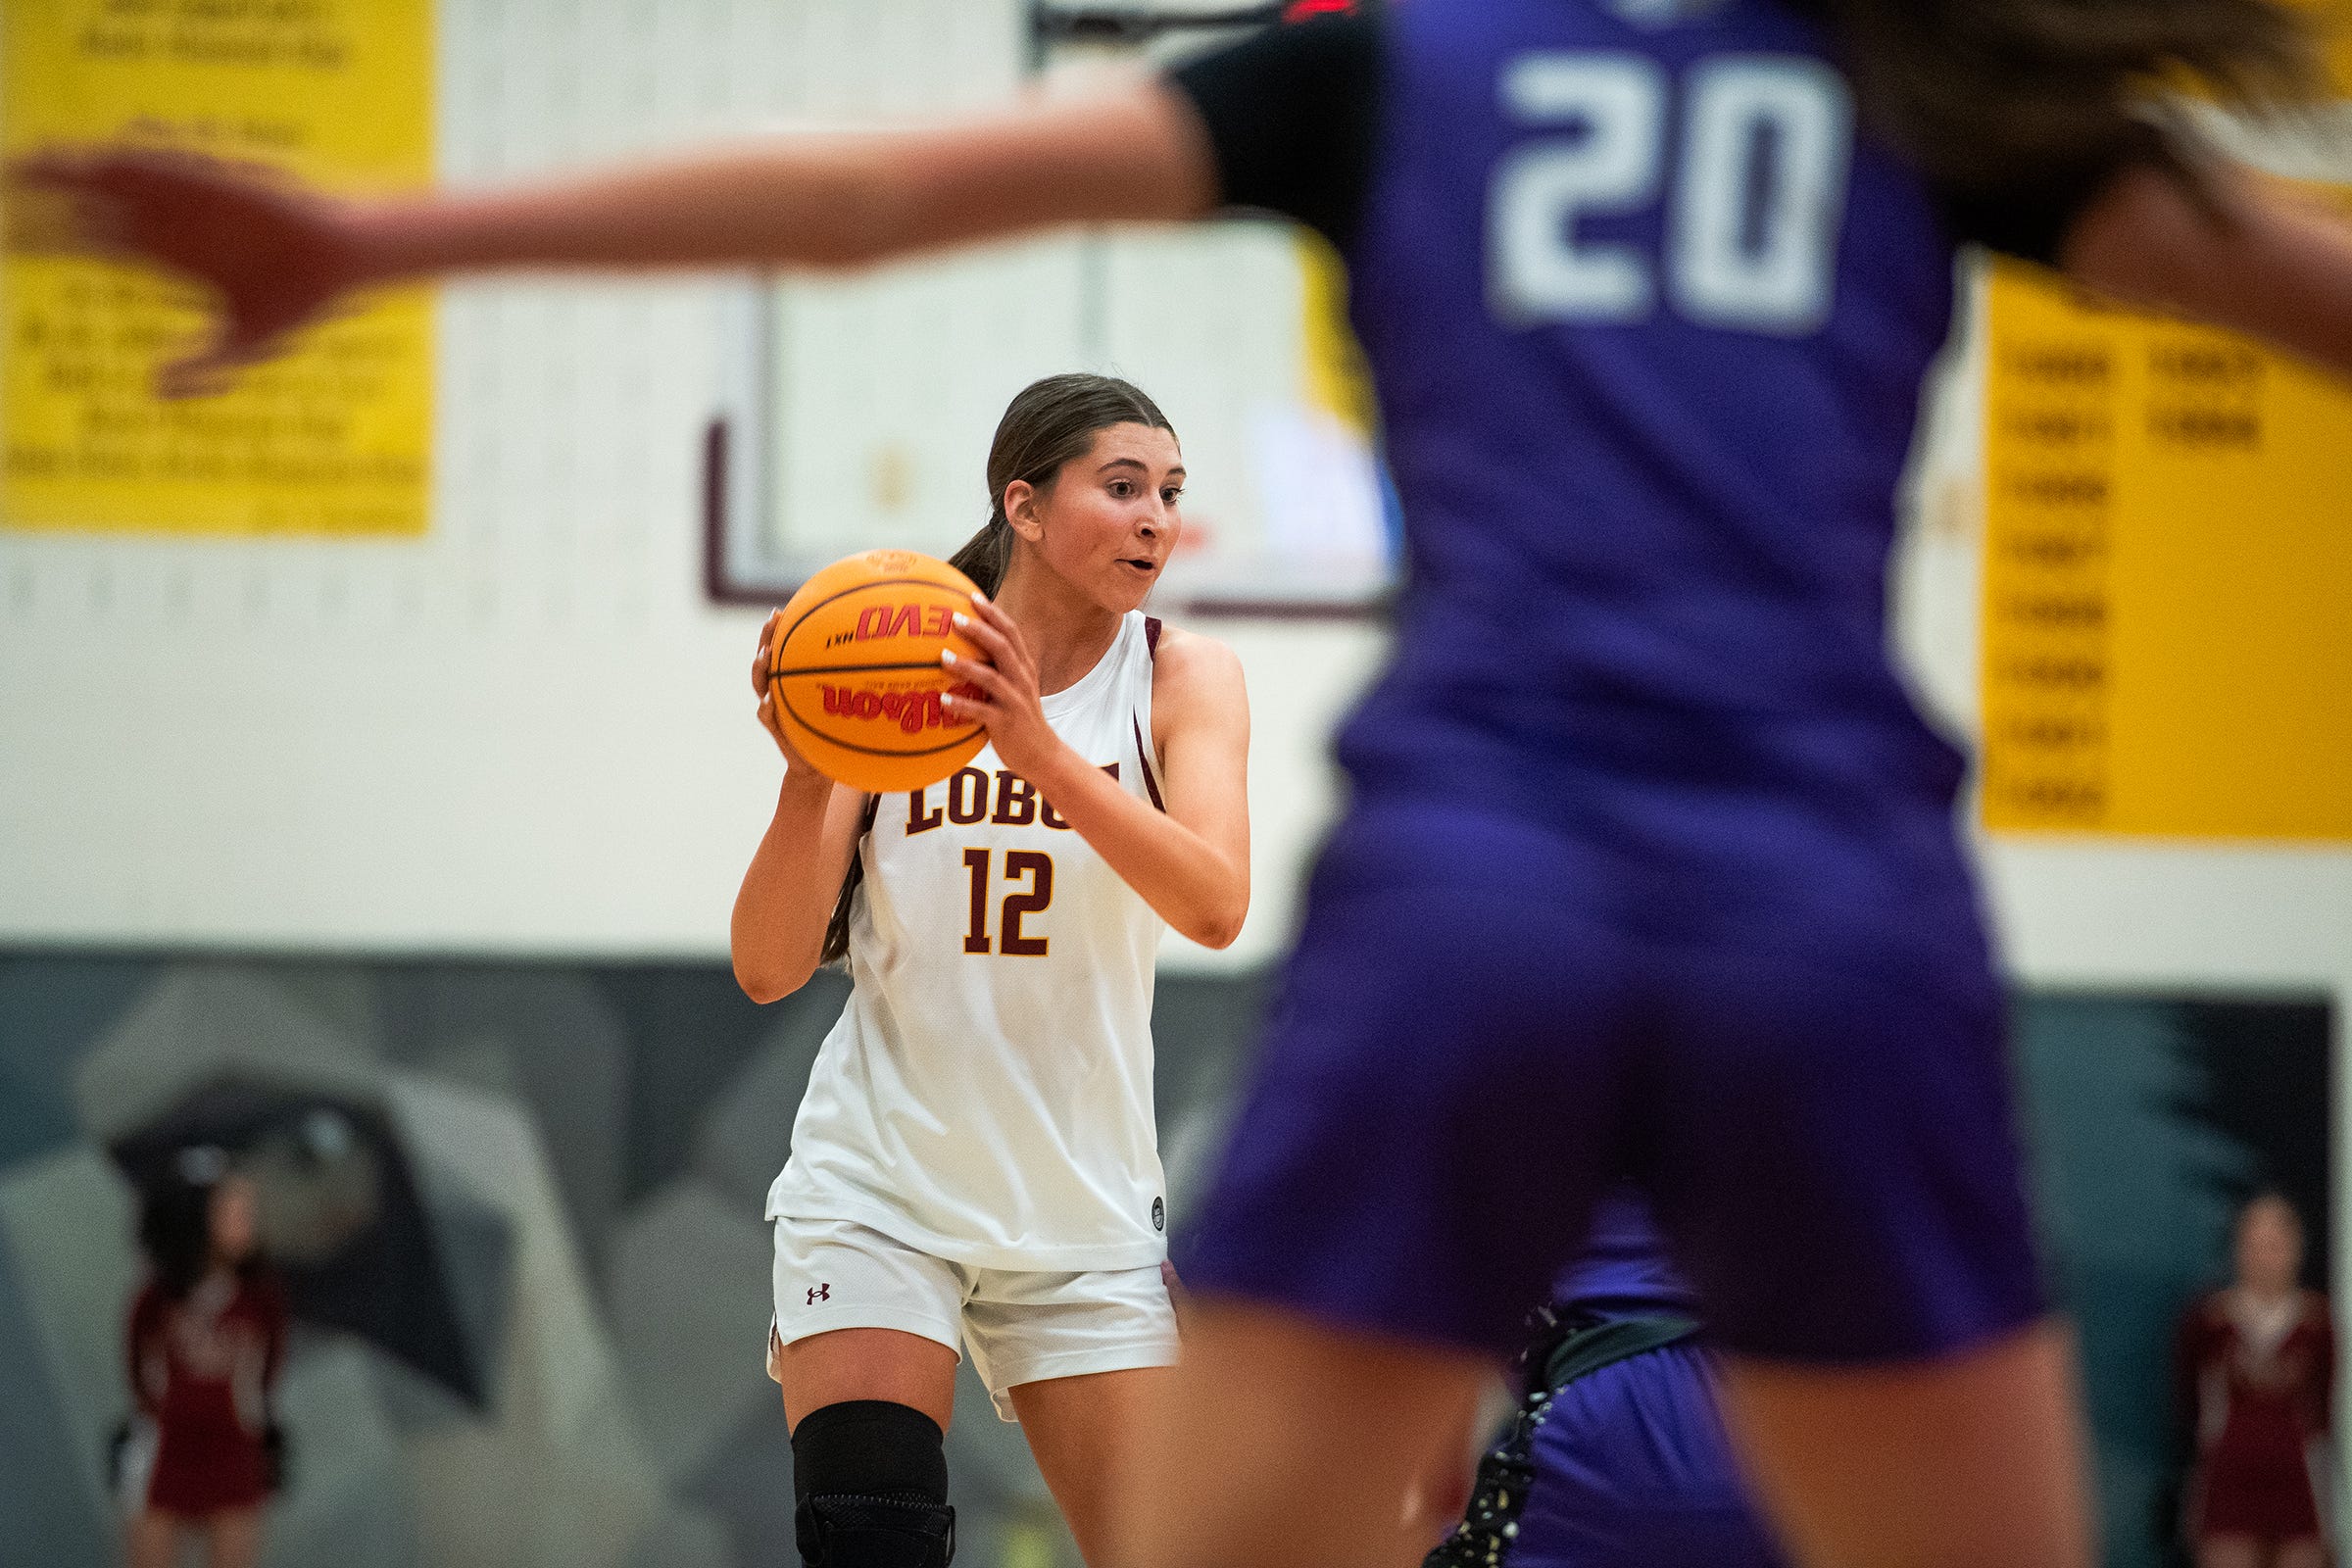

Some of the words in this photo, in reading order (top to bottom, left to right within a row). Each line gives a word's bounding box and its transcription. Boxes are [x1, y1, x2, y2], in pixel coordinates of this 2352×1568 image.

[1488, 51, 1852, 331] 20
[856, 604, 953, 642] EVO
[962, 847, 1054, 956] 12
